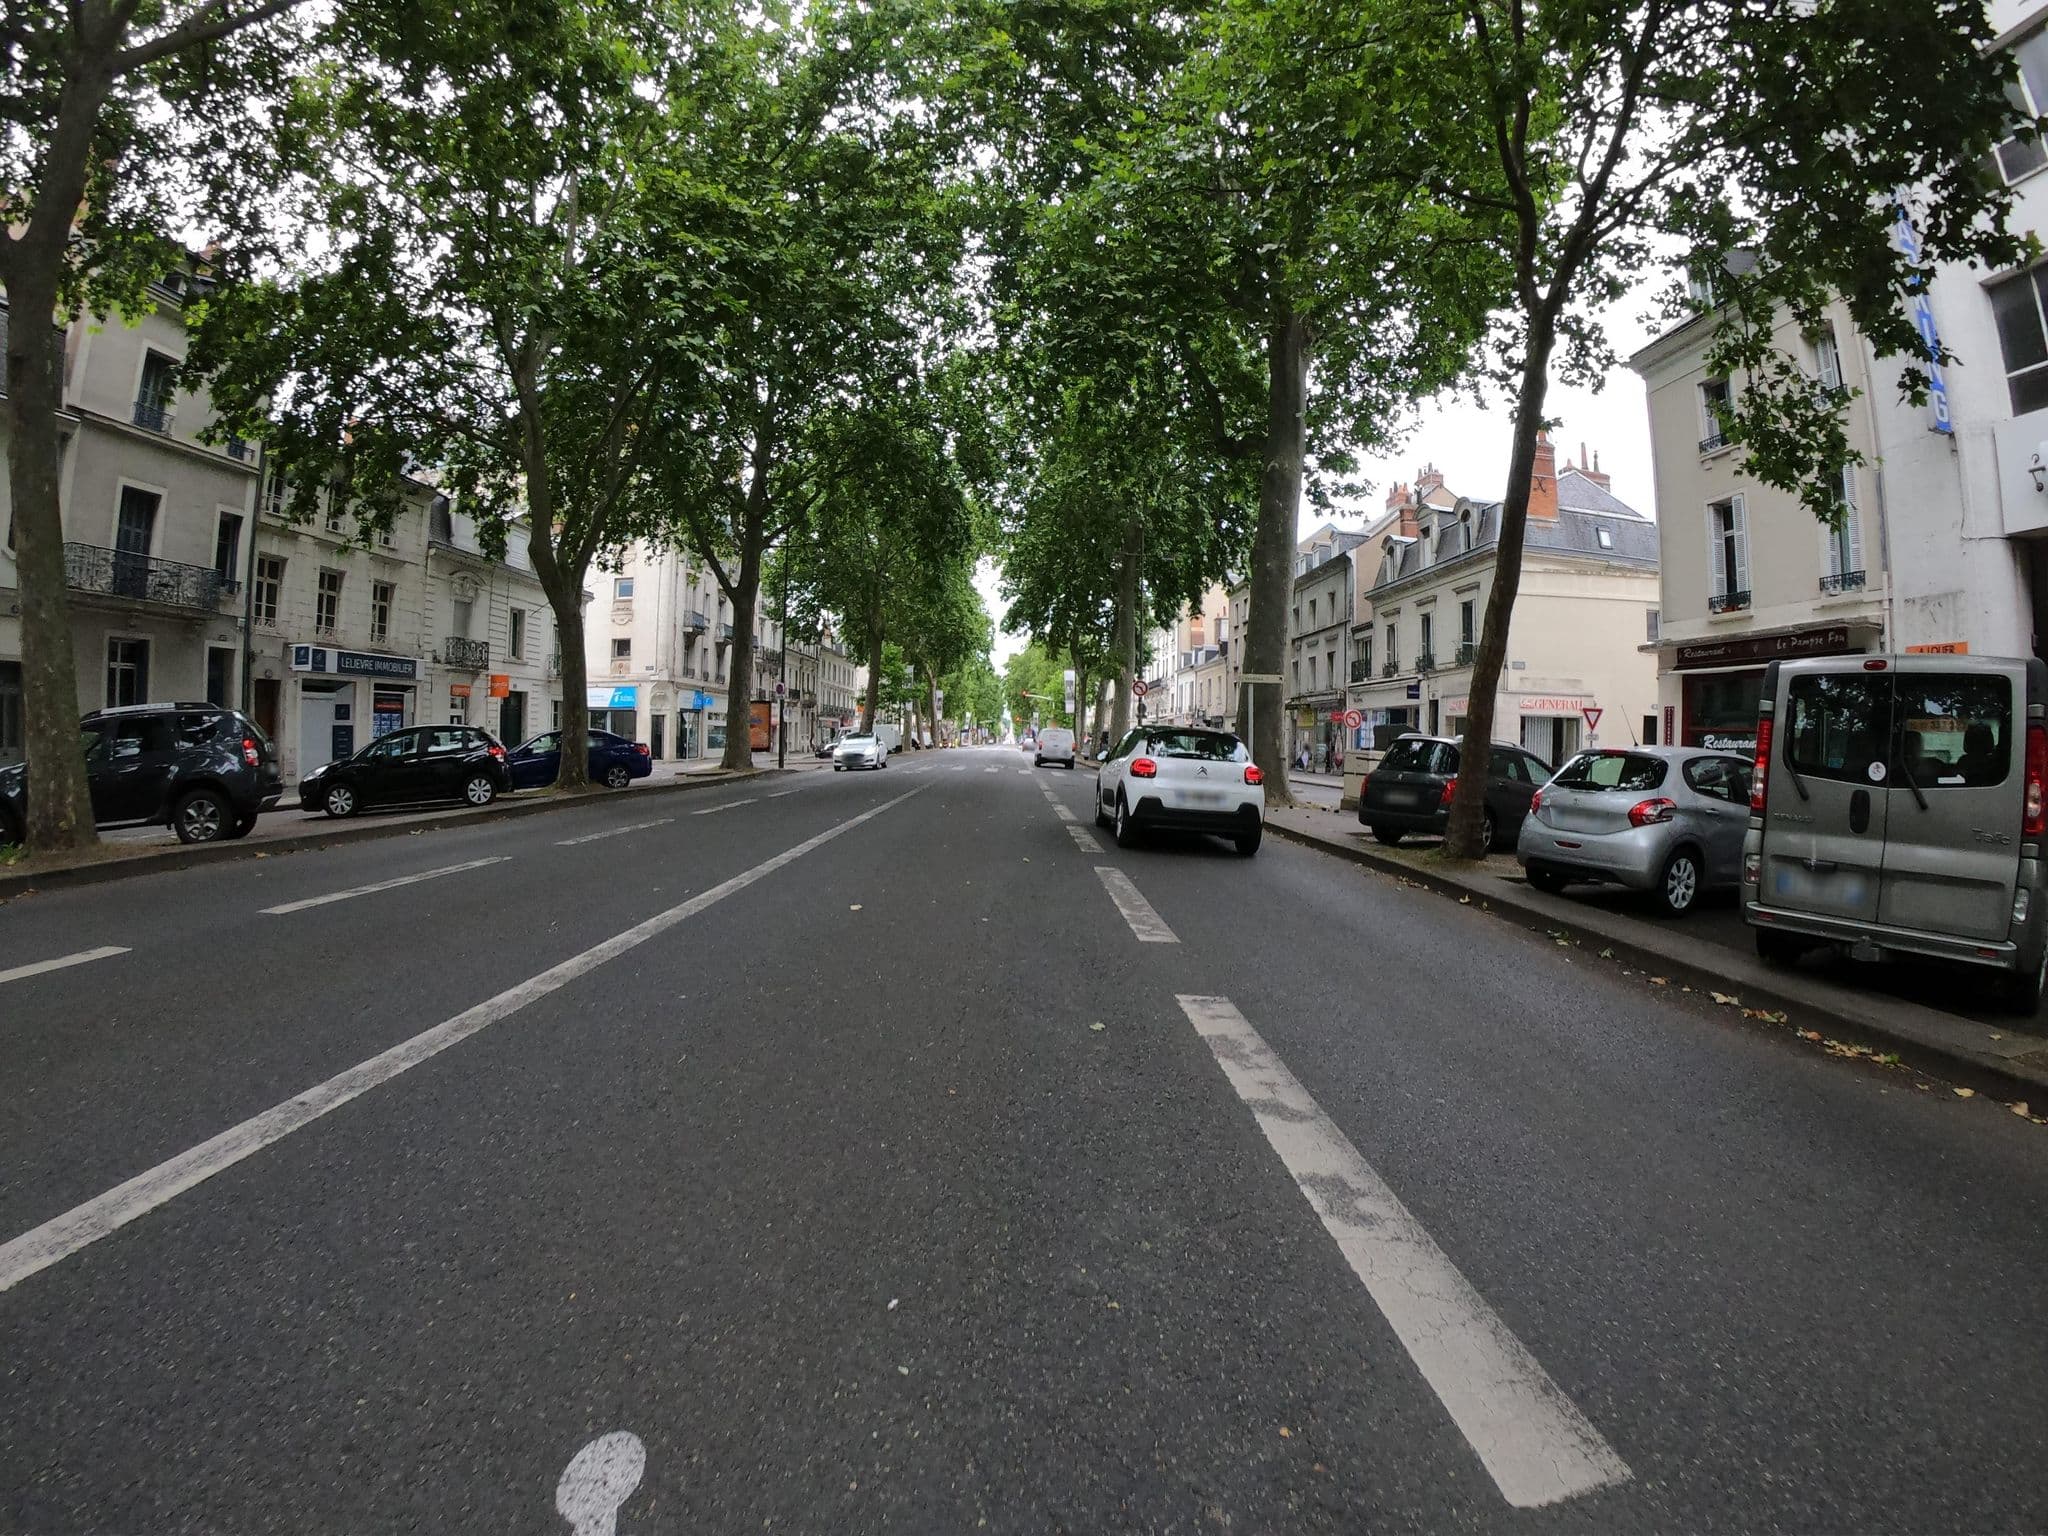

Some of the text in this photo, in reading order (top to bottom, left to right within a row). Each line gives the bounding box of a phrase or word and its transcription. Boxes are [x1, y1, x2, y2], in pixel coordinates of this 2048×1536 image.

[1894, 186, 1949, 423] AKING
[1776, 638, 1787, 650] Le
[341, 657, 414, 674] LELIEVRE IMMOBILIER
[1534, 698, 1584, 711] GENERALI
[1703, 734, 1757, 750] Restauran
